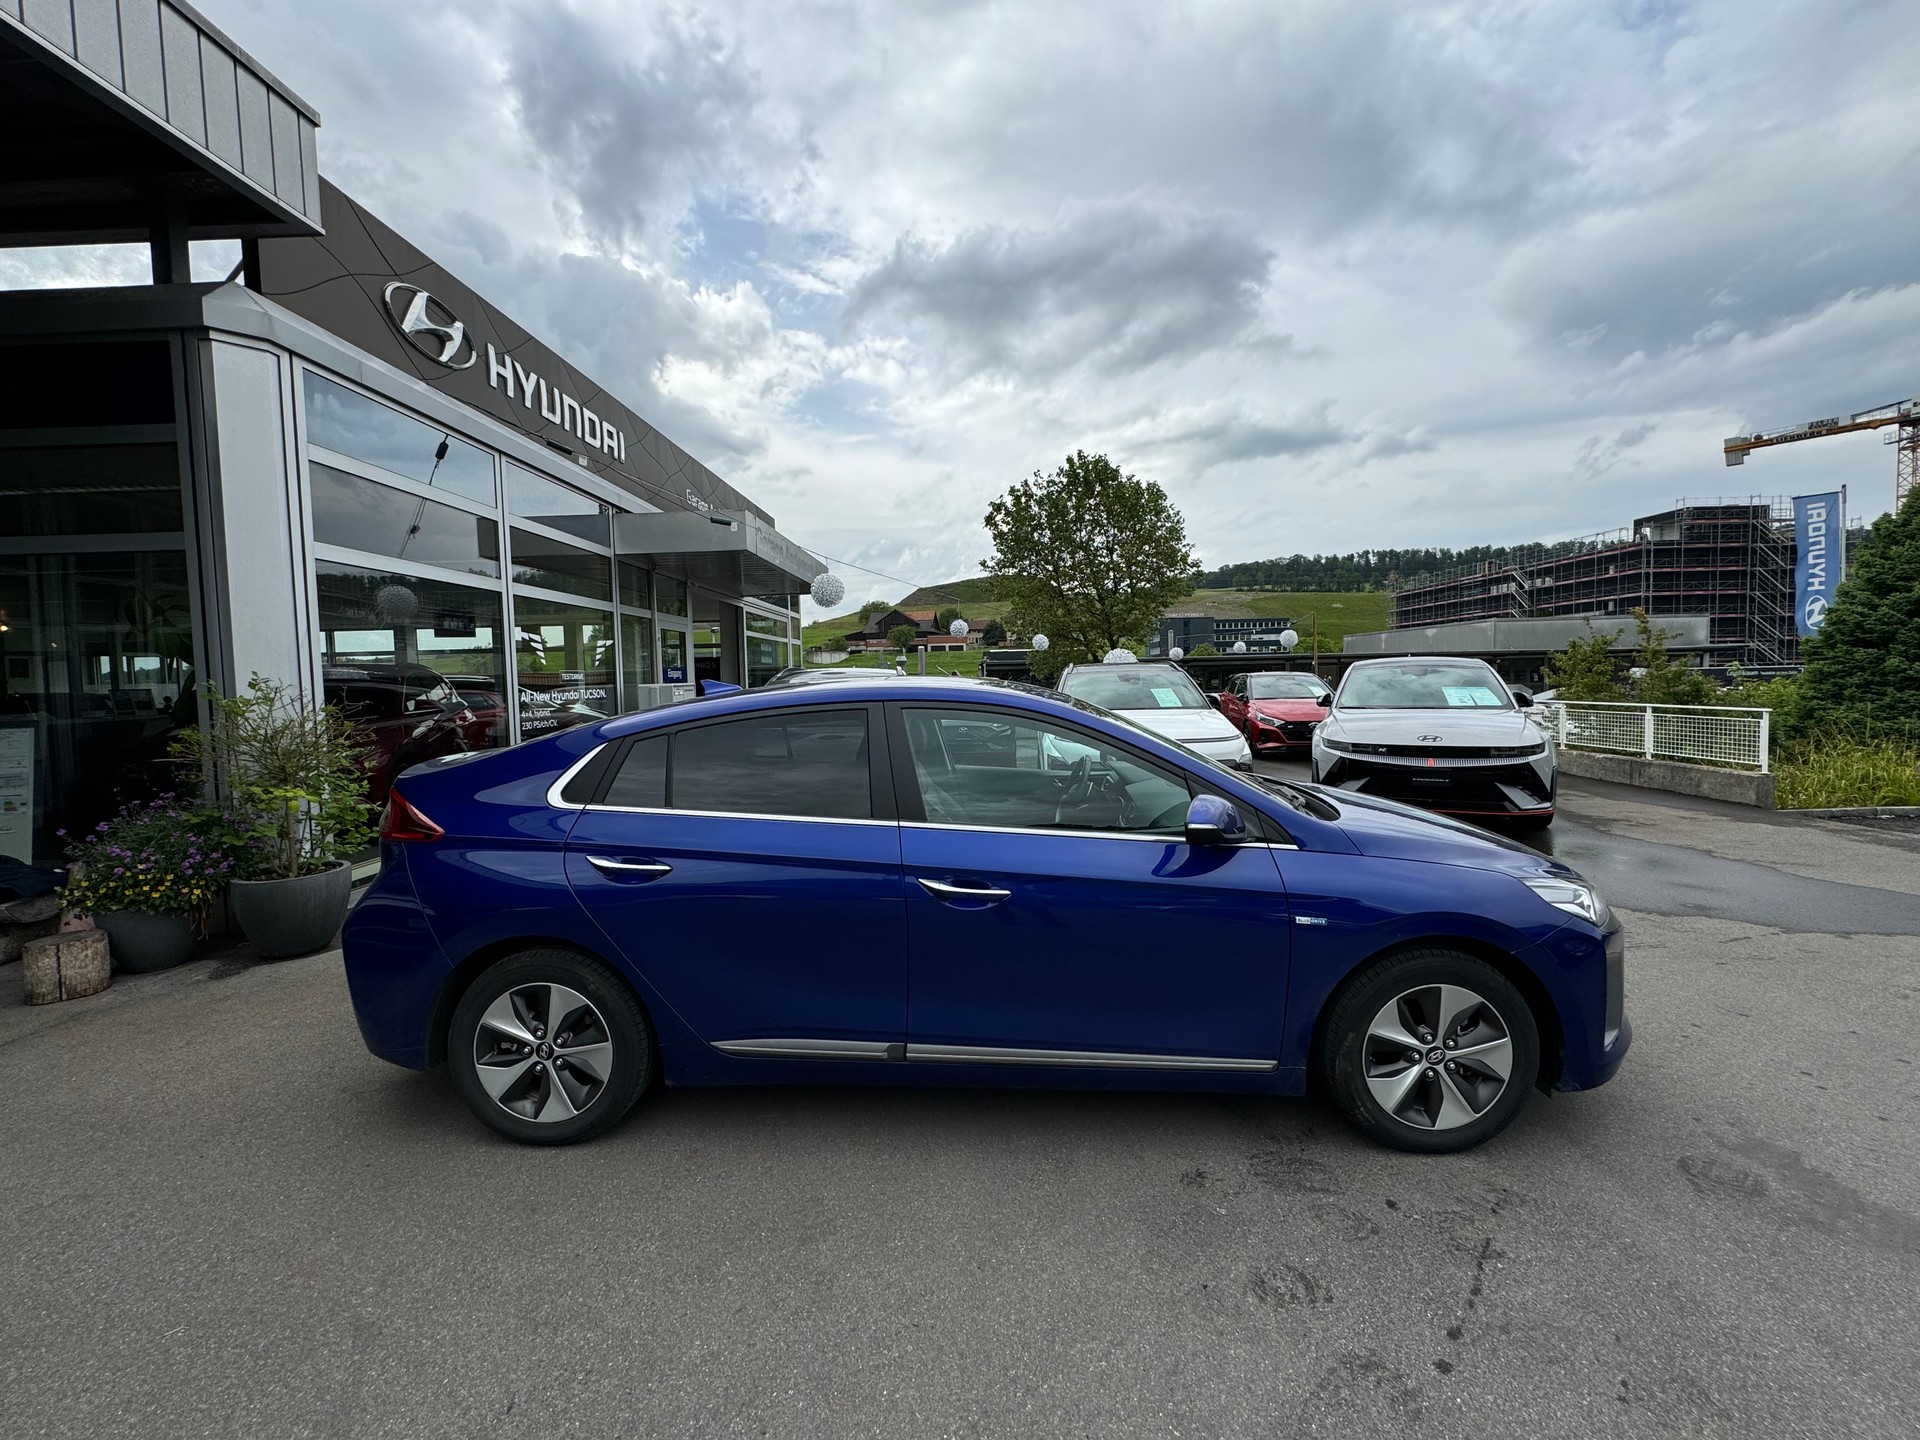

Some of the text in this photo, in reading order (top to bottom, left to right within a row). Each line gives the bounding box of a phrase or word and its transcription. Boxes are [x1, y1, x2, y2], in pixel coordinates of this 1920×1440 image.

[487, 342, 625, 464] HYUNDAI
[520, 691, 550, 702] All-New
[551, 689, 579, 702] Hyundai
[522, 722, 532, 730] 230
